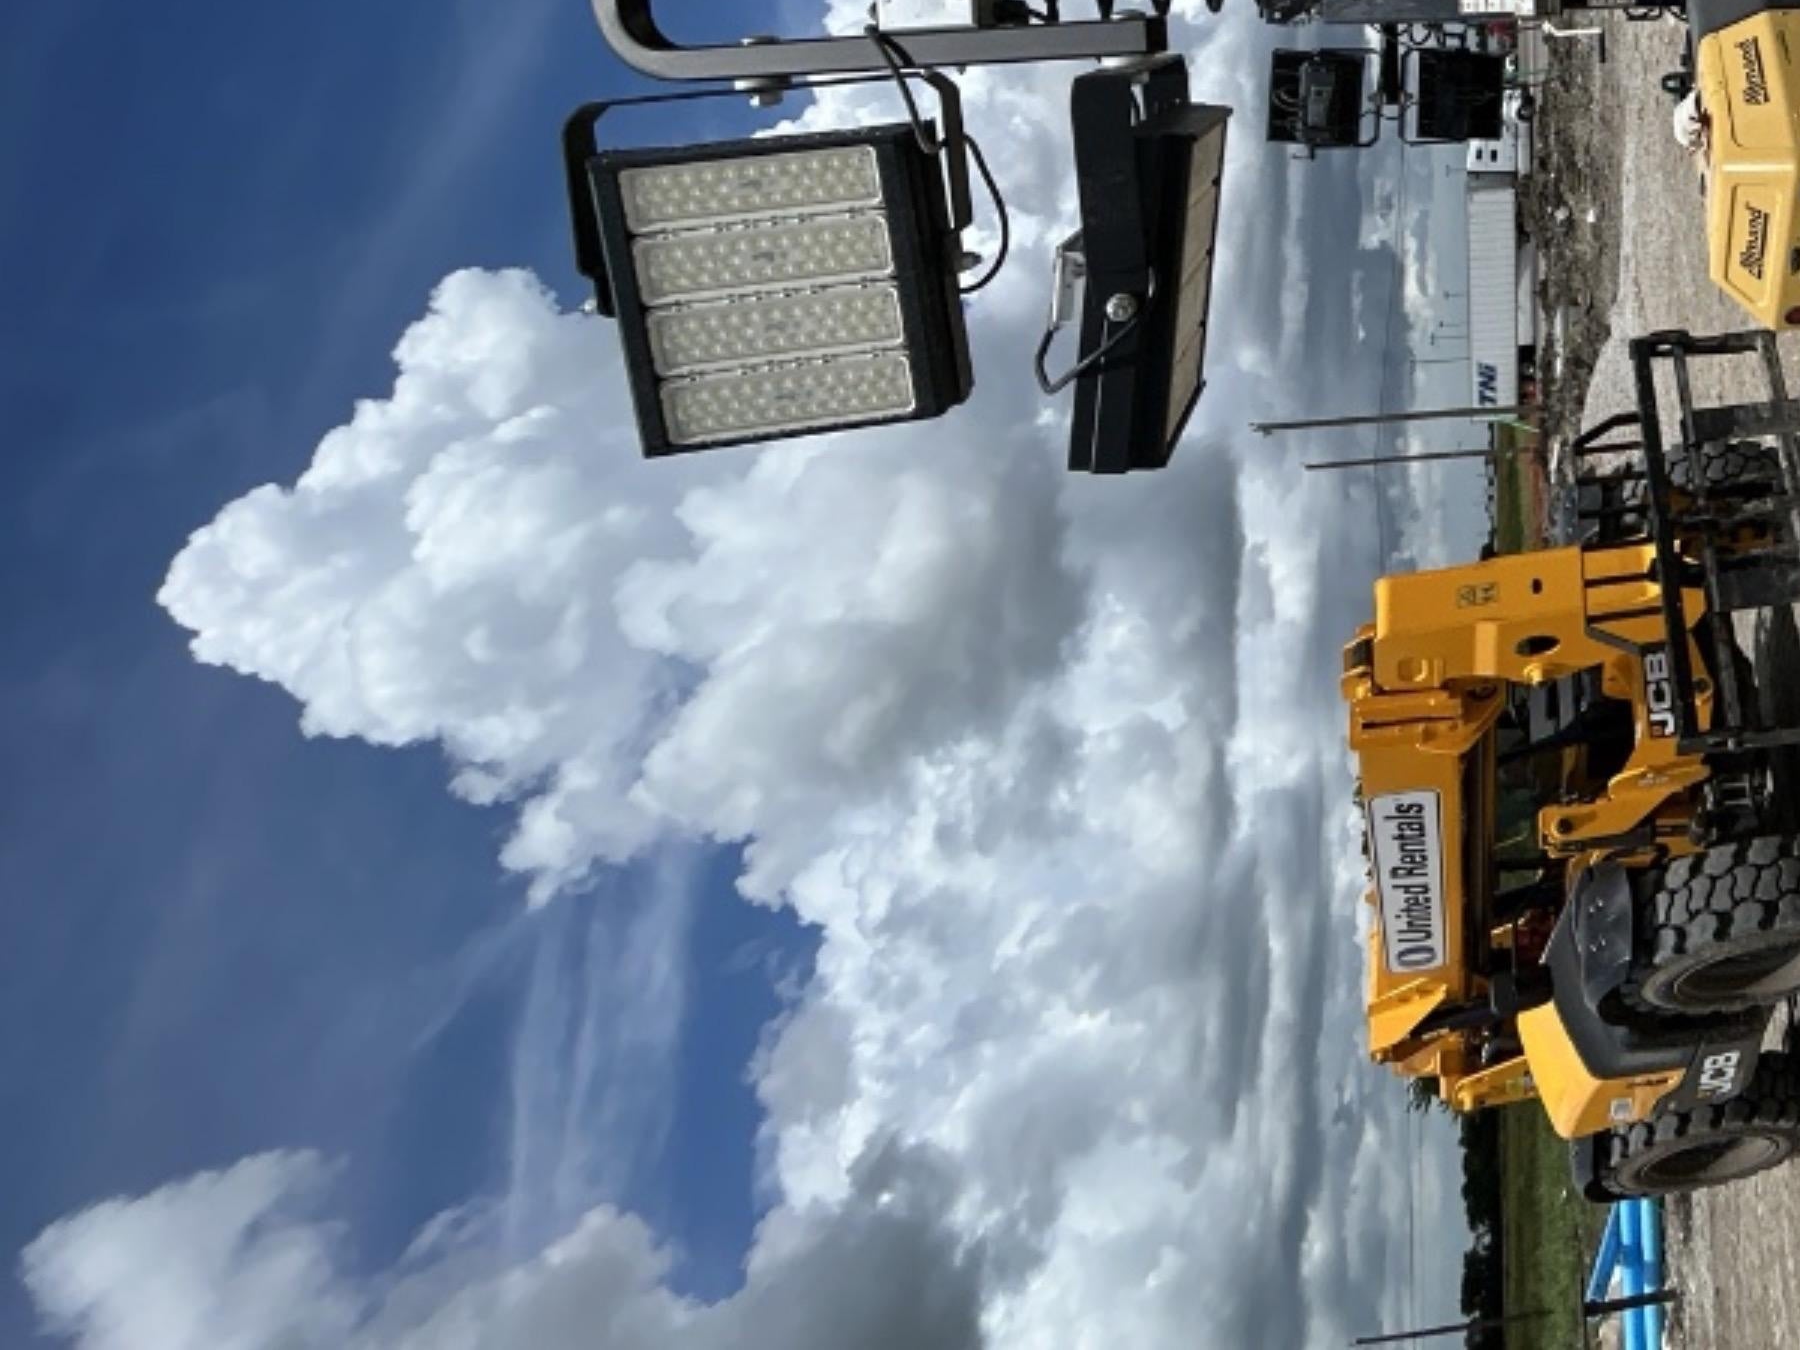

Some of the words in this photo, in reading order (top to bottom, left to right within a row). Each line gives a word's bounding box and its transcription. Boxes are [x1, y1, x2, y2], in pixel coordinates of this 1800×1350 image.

[1644, 653, 1675, 736] JCB
[1383, 802, 1428, 879] Rentals
[1391, 884, 1432, 942] United
[1698, 1051, 1740, 1093] JCB
